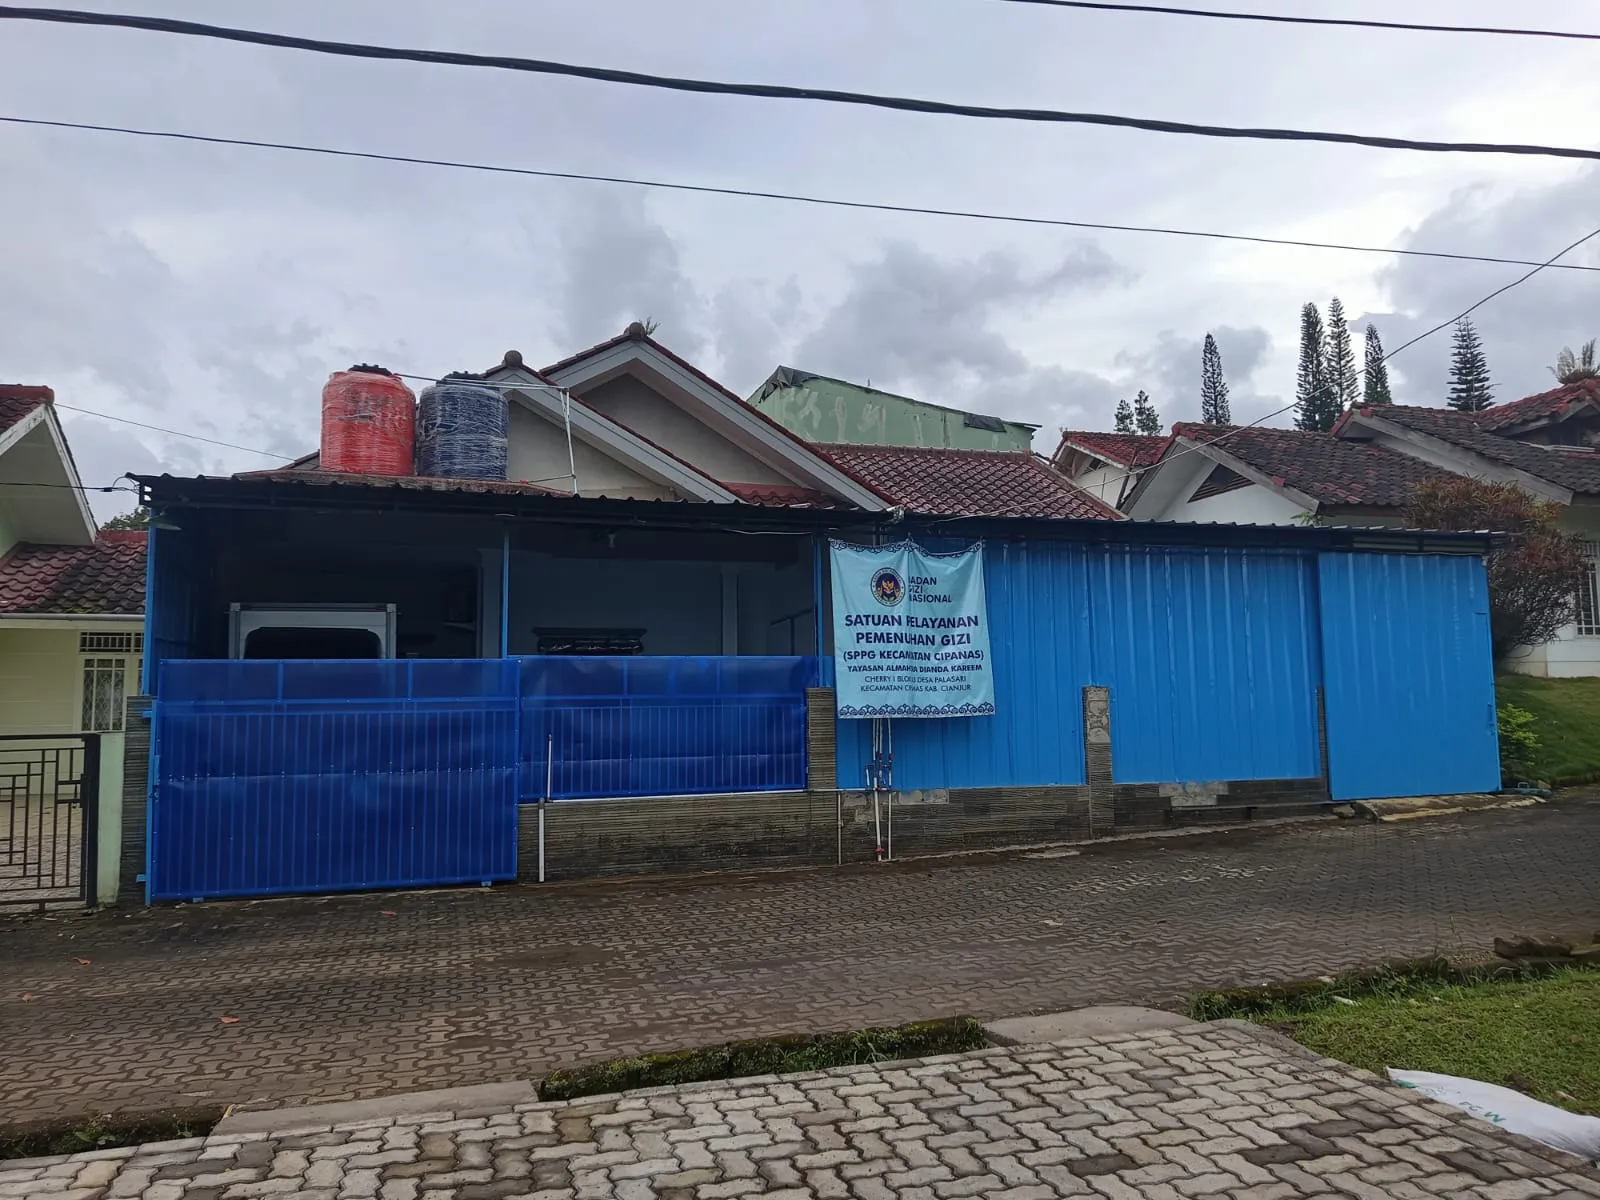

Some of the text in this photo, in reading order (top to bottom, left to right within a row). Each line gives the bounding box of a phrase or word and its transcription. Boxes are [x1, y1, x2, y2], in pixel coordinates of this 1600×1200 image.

[908, 576, 937, 586] ADAN
[845, 614, 979, 628] SATUAN PELAYANAN
[856, 632, 971, 646] PEMENUHAN GIZI
[843, 650, 984, 662] (SPPG KECAMATAN CIPANAS)
[847, 664, 884, 673] YAYASAN
[951, 664, 983, 672] KAREEM
[864, 675, 891, 683] CHERRY
[861, 684, 903, 692] KECAMATAN
[941, 684, 972, 692] CIANJUR
